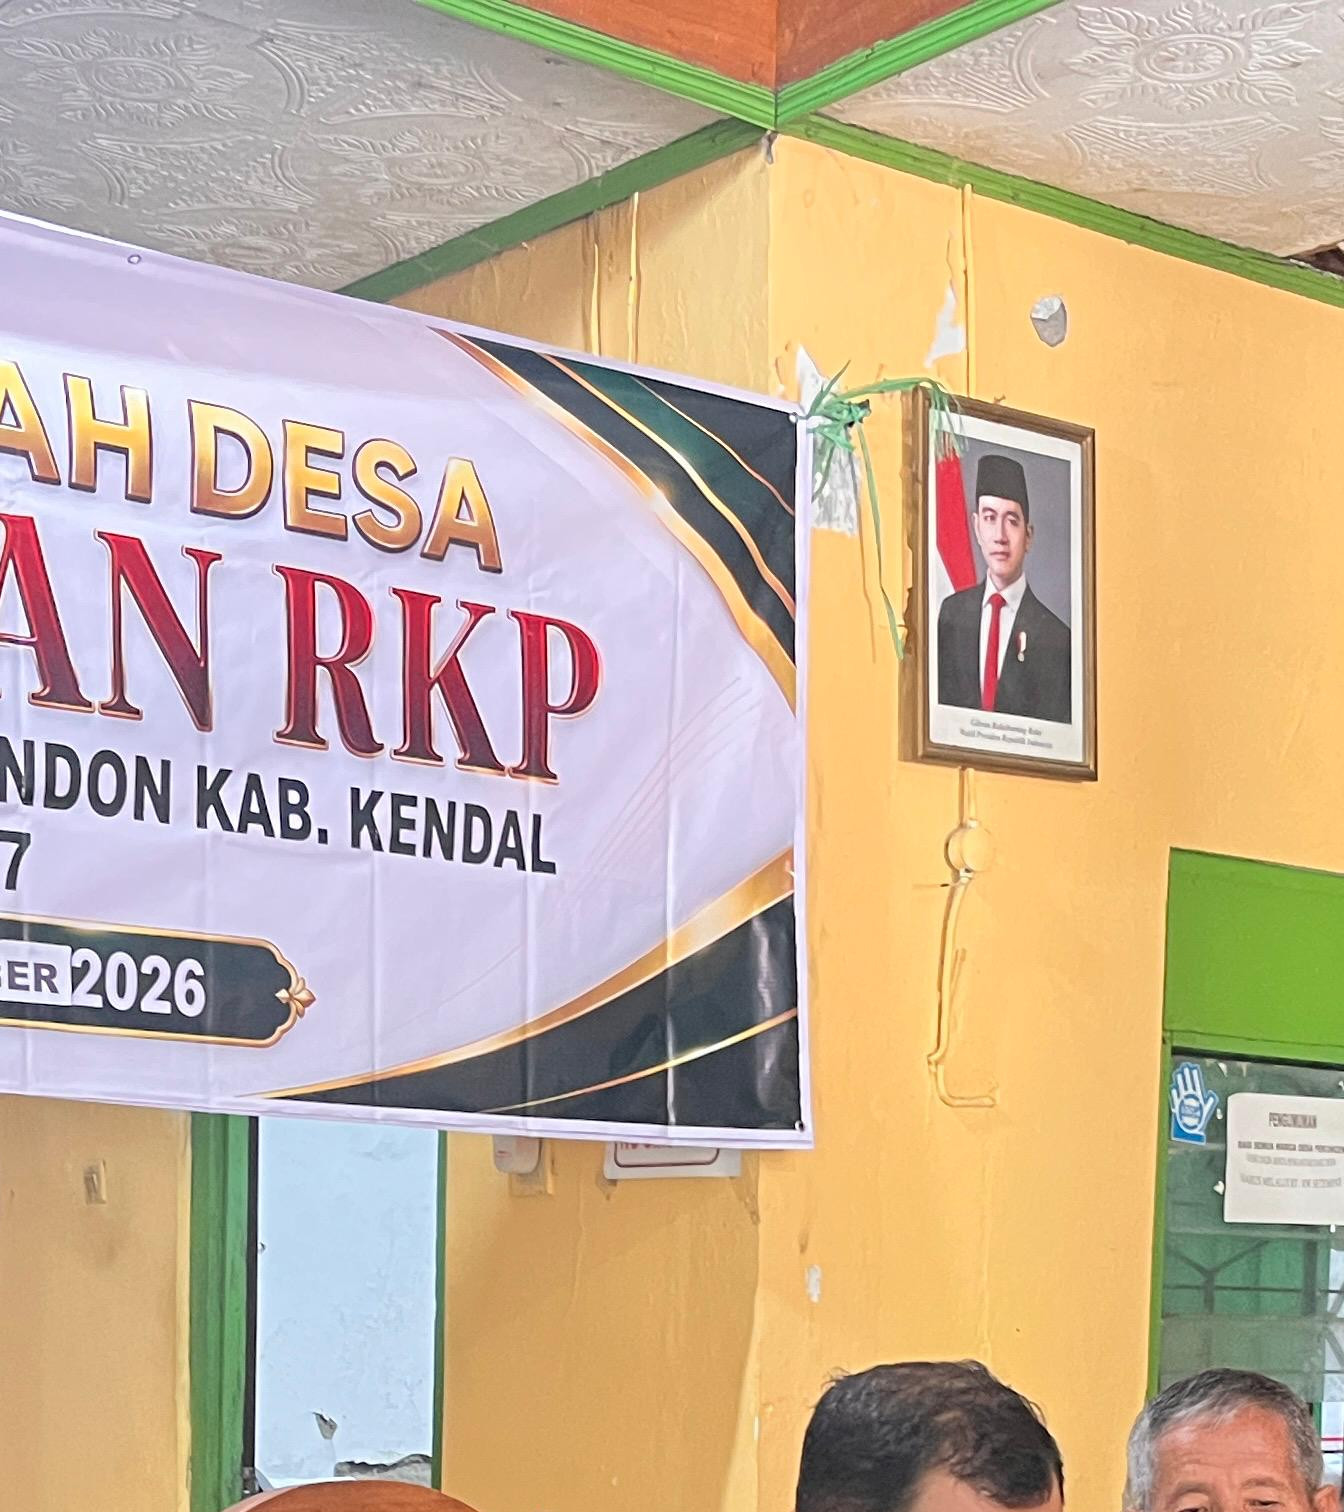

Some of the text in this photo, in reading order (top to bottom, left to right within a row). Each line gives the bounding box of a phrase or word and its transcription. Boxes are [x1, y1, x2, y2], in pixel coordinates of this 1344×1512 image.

[187, 399, 502, 573] DESA
[271, 563, 602, 785] RKP
[194, 765, 329, 845] KAB.
[348, 786, 557, 875] KENDAL
[71, 950, 207, 1018] 2026
